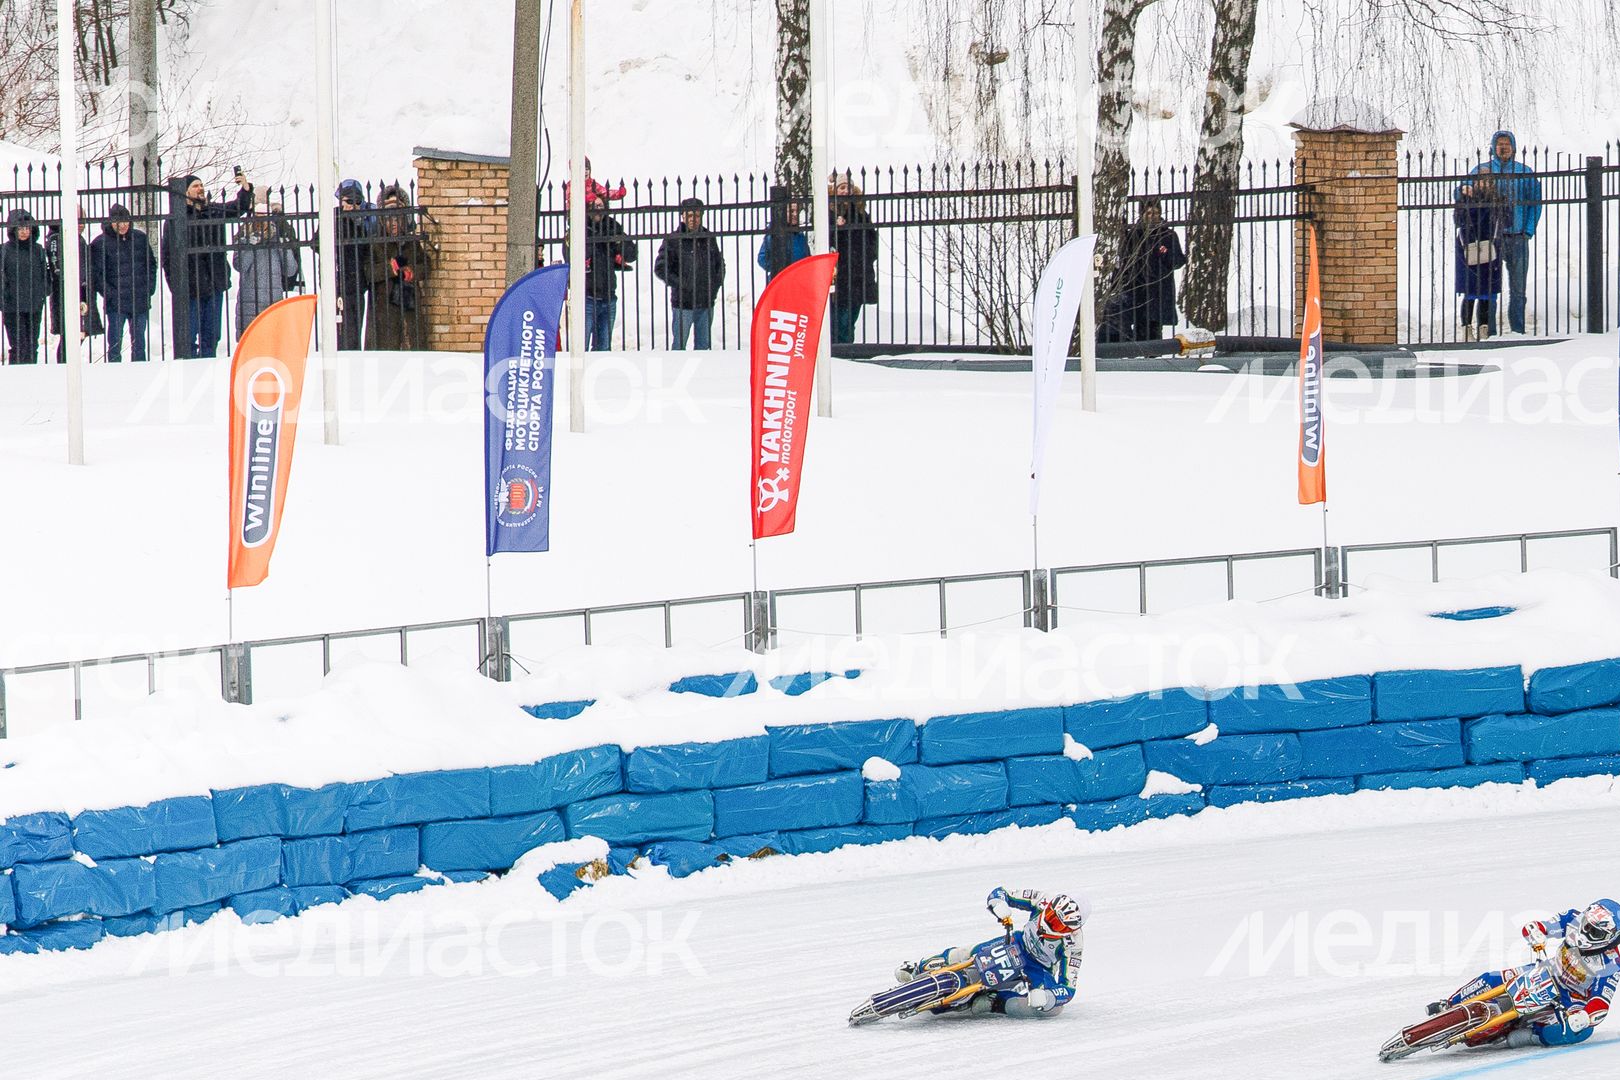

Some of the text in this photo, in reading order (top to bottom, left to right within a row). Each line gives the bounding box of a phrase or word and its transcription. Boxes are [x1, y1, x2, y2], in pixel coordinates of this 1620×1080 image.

[515, 310, 534, 451] МОТОЦИКЛЕТНОГО
[760, 310, 797, 465] YAKHNICH
[794, 315, 808, 359] yms.ru
[505, 360, 517, 451] ФЕДЕРАЦИЯ
[528, 329, 545, 451] СПОРТА РОССИИ
[780, 390, 797, 464] motorsport
[245, 418, 274, 532] winline
[991, 945, 1015, 981] UFA
